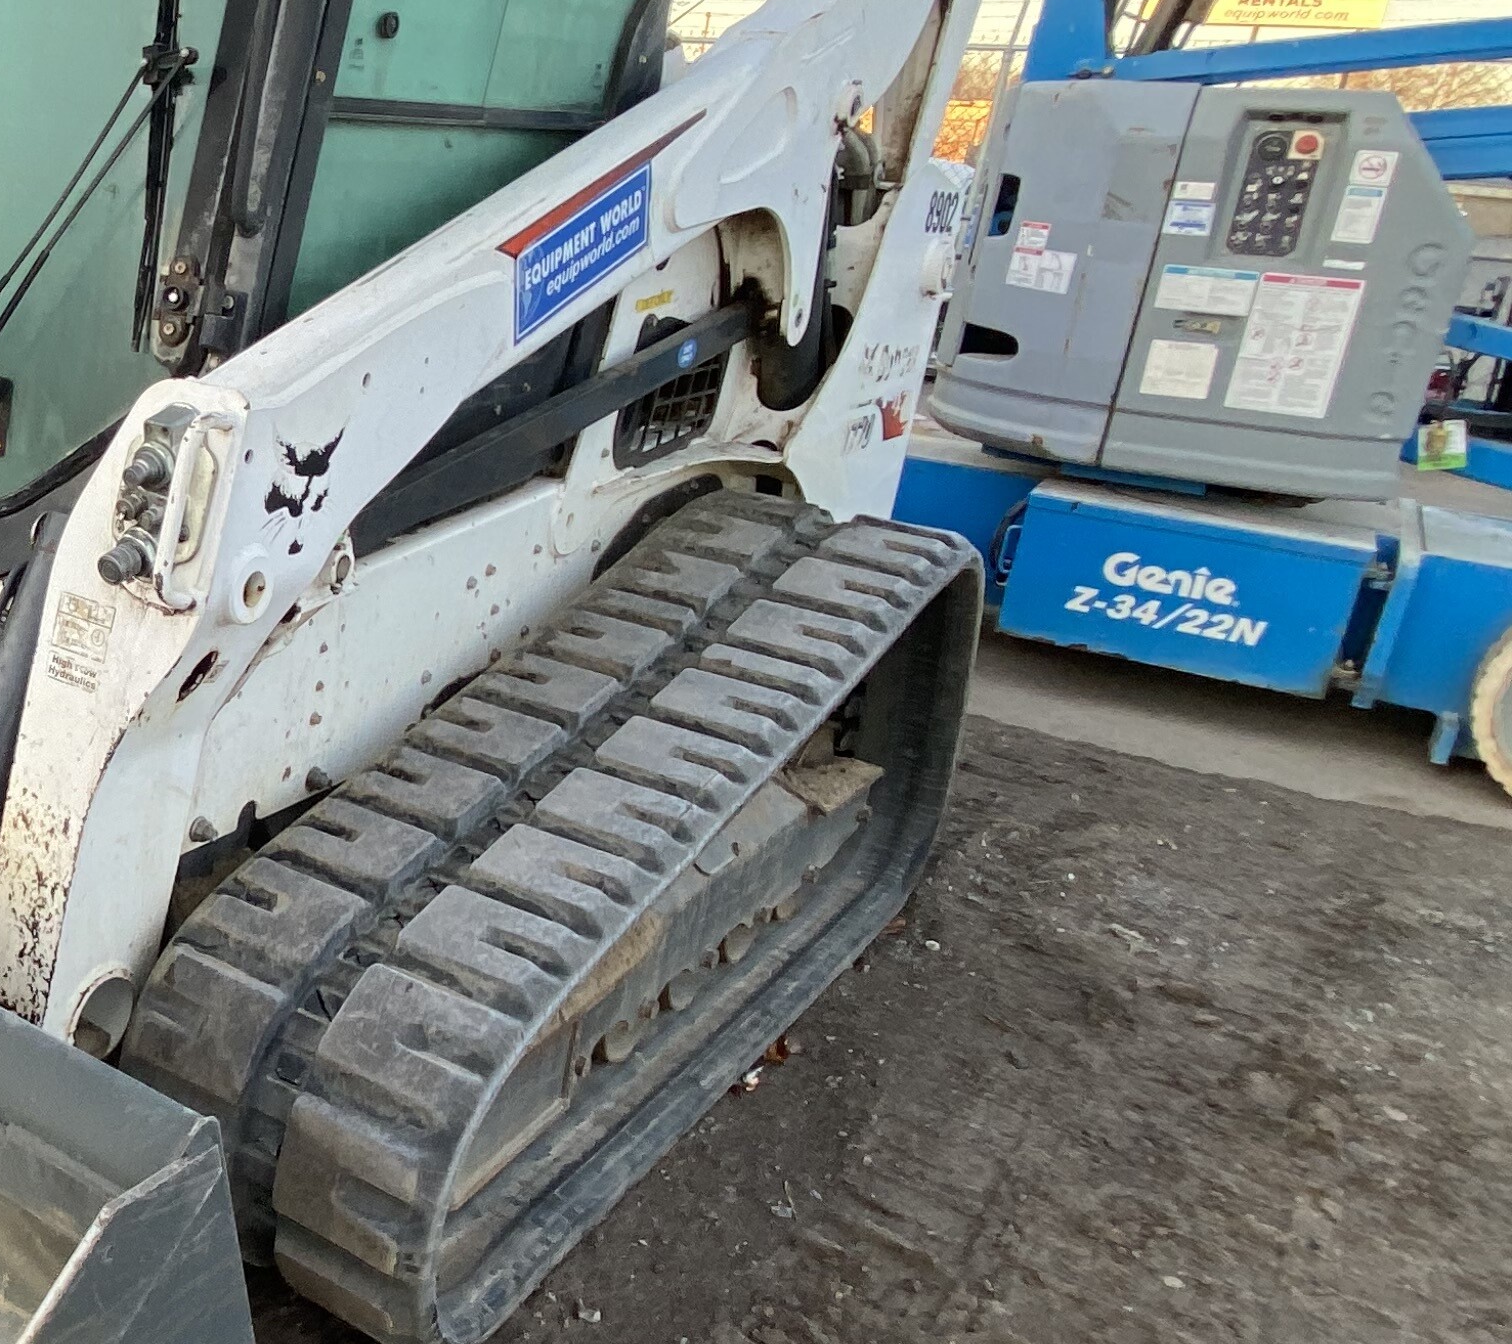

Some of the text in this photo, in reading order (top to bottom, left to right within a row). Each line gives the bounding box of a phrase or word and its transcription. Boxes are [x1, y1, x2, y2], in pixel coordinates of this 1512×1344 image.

[925, 190, 959, 233] 8902
[524, 189, 642, 291] EQUIPMENT WORLD
[546, 216, 640, 296] equipworld.com
[1064, 585, 1269, 647] Z-34/22N
[48, 664, 96, 690] Hydraulics
[52, 654, 73, 670] High
